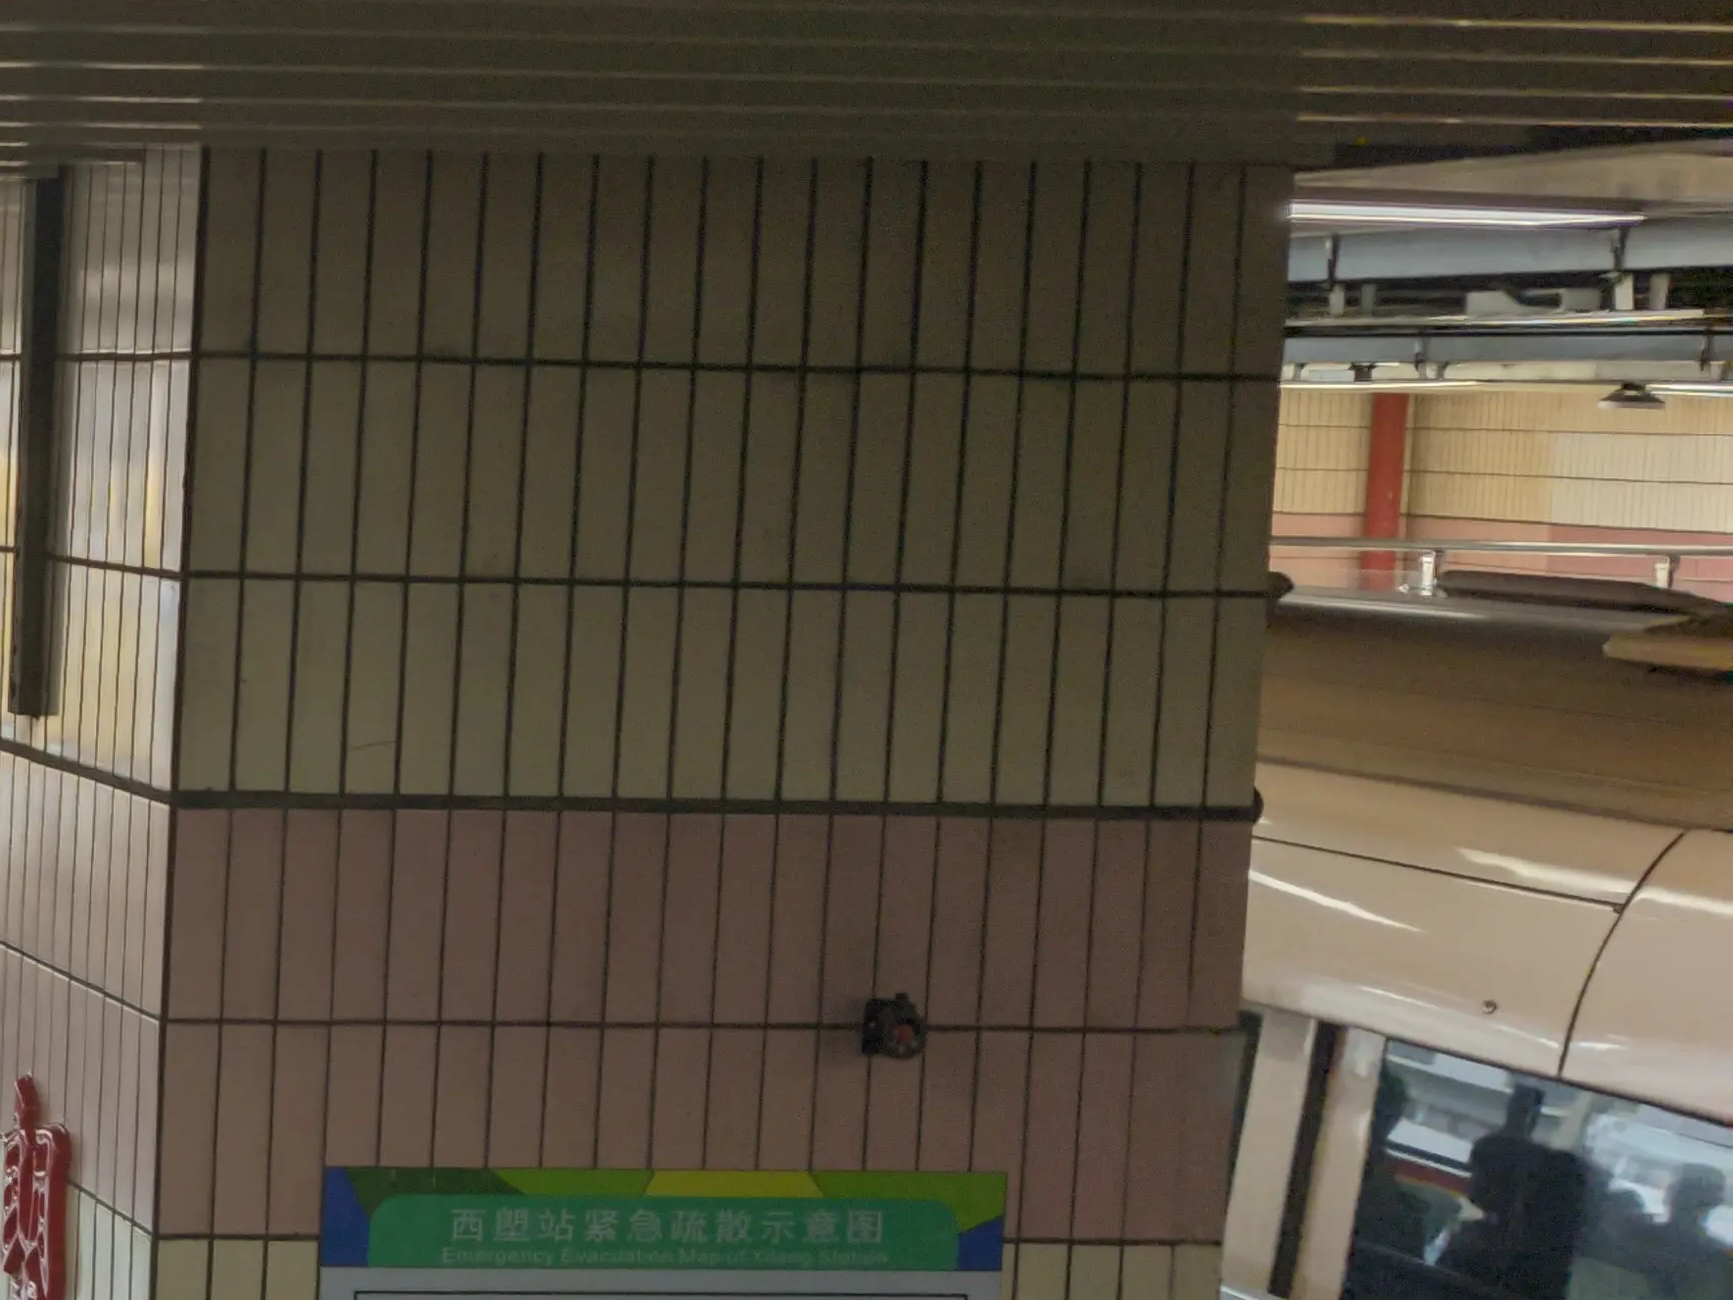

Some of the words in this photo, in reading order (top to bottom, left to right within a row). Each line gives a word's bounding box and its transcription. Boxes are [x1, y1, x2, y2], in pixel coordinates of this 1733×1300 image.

[449, 1207, 884, 1244] 西塱站紧急疏散示意图
[441, 1247, 553, 1268] Emergency
